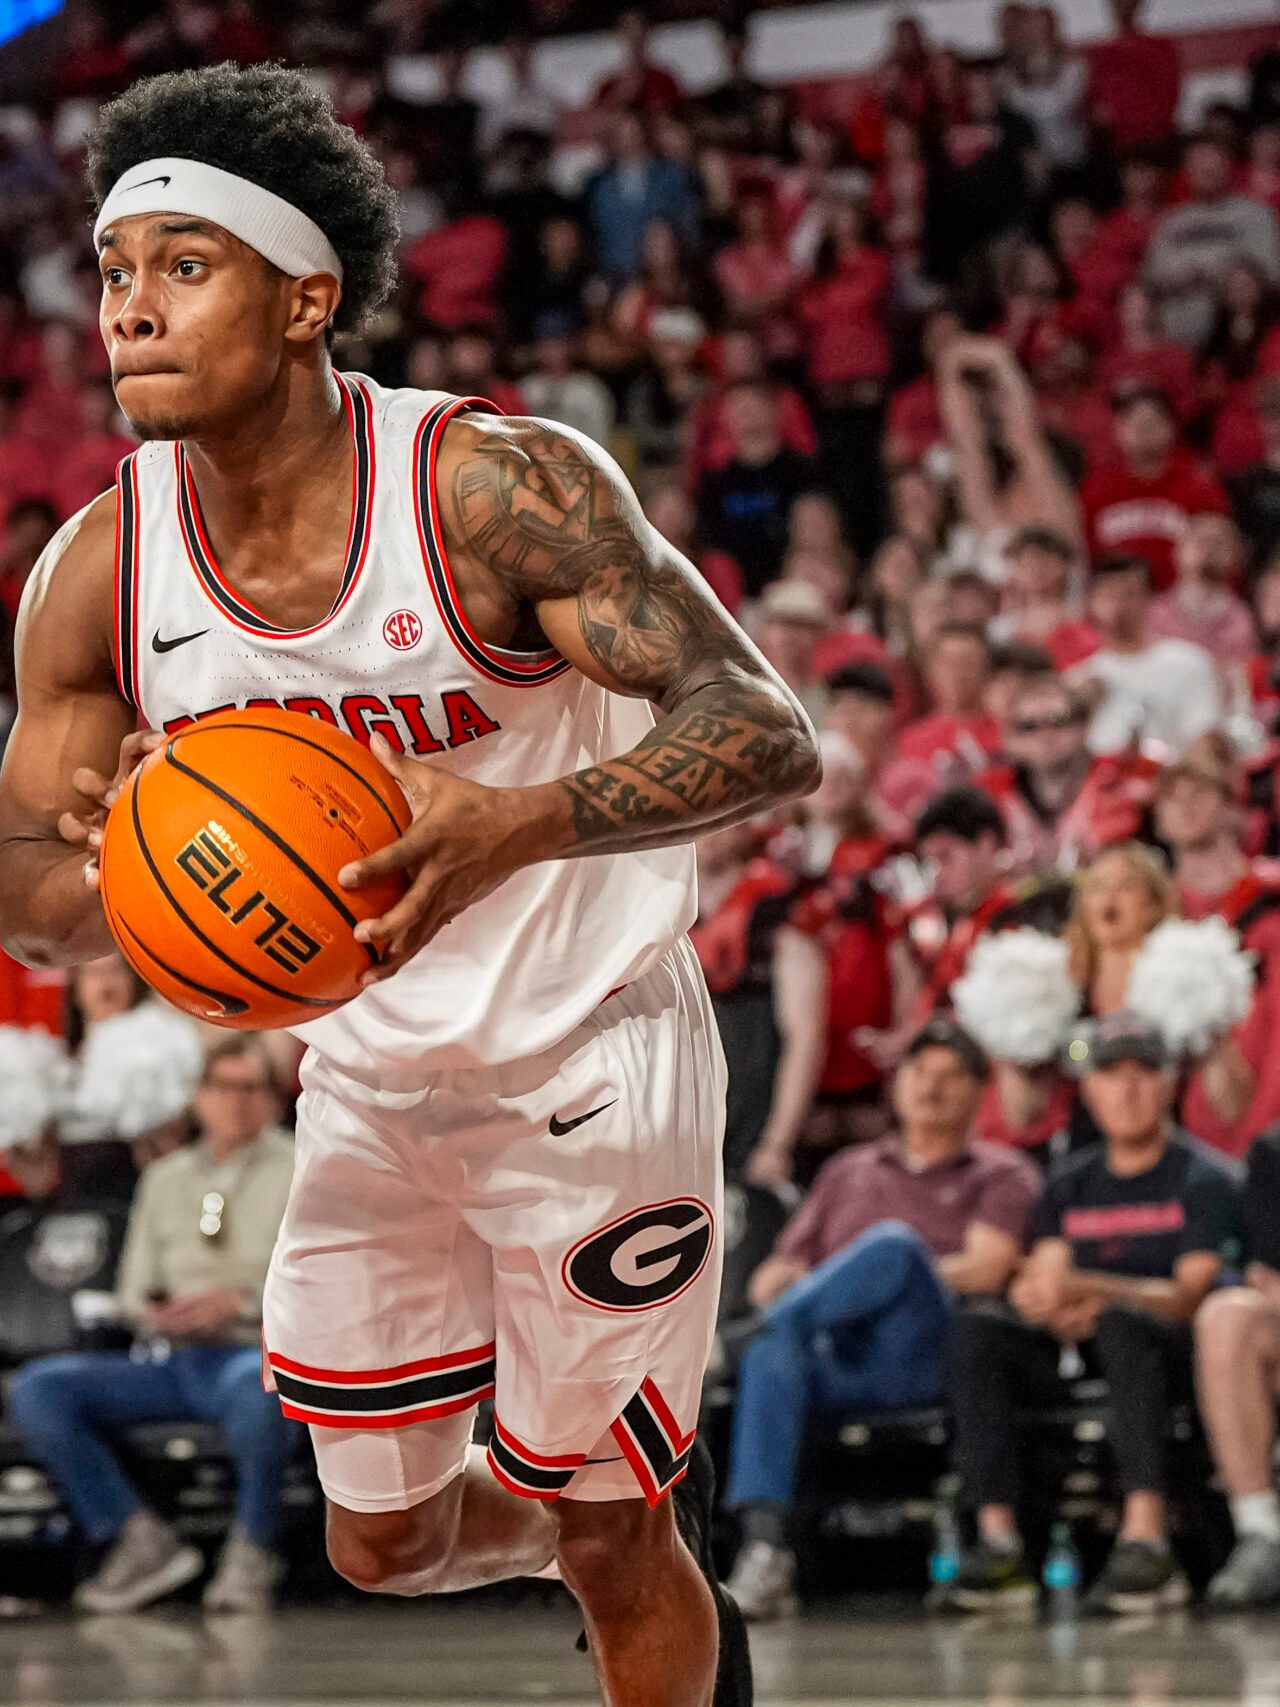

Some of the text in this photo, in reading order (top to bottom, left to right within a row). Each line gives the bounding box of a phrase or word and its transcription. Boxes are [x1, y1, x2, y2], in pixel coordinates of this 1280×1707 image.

[386, 612, 420, 647] SEC
[174, 827, 324, 976] ELITE
[569, 1203, 711, 1307] G
